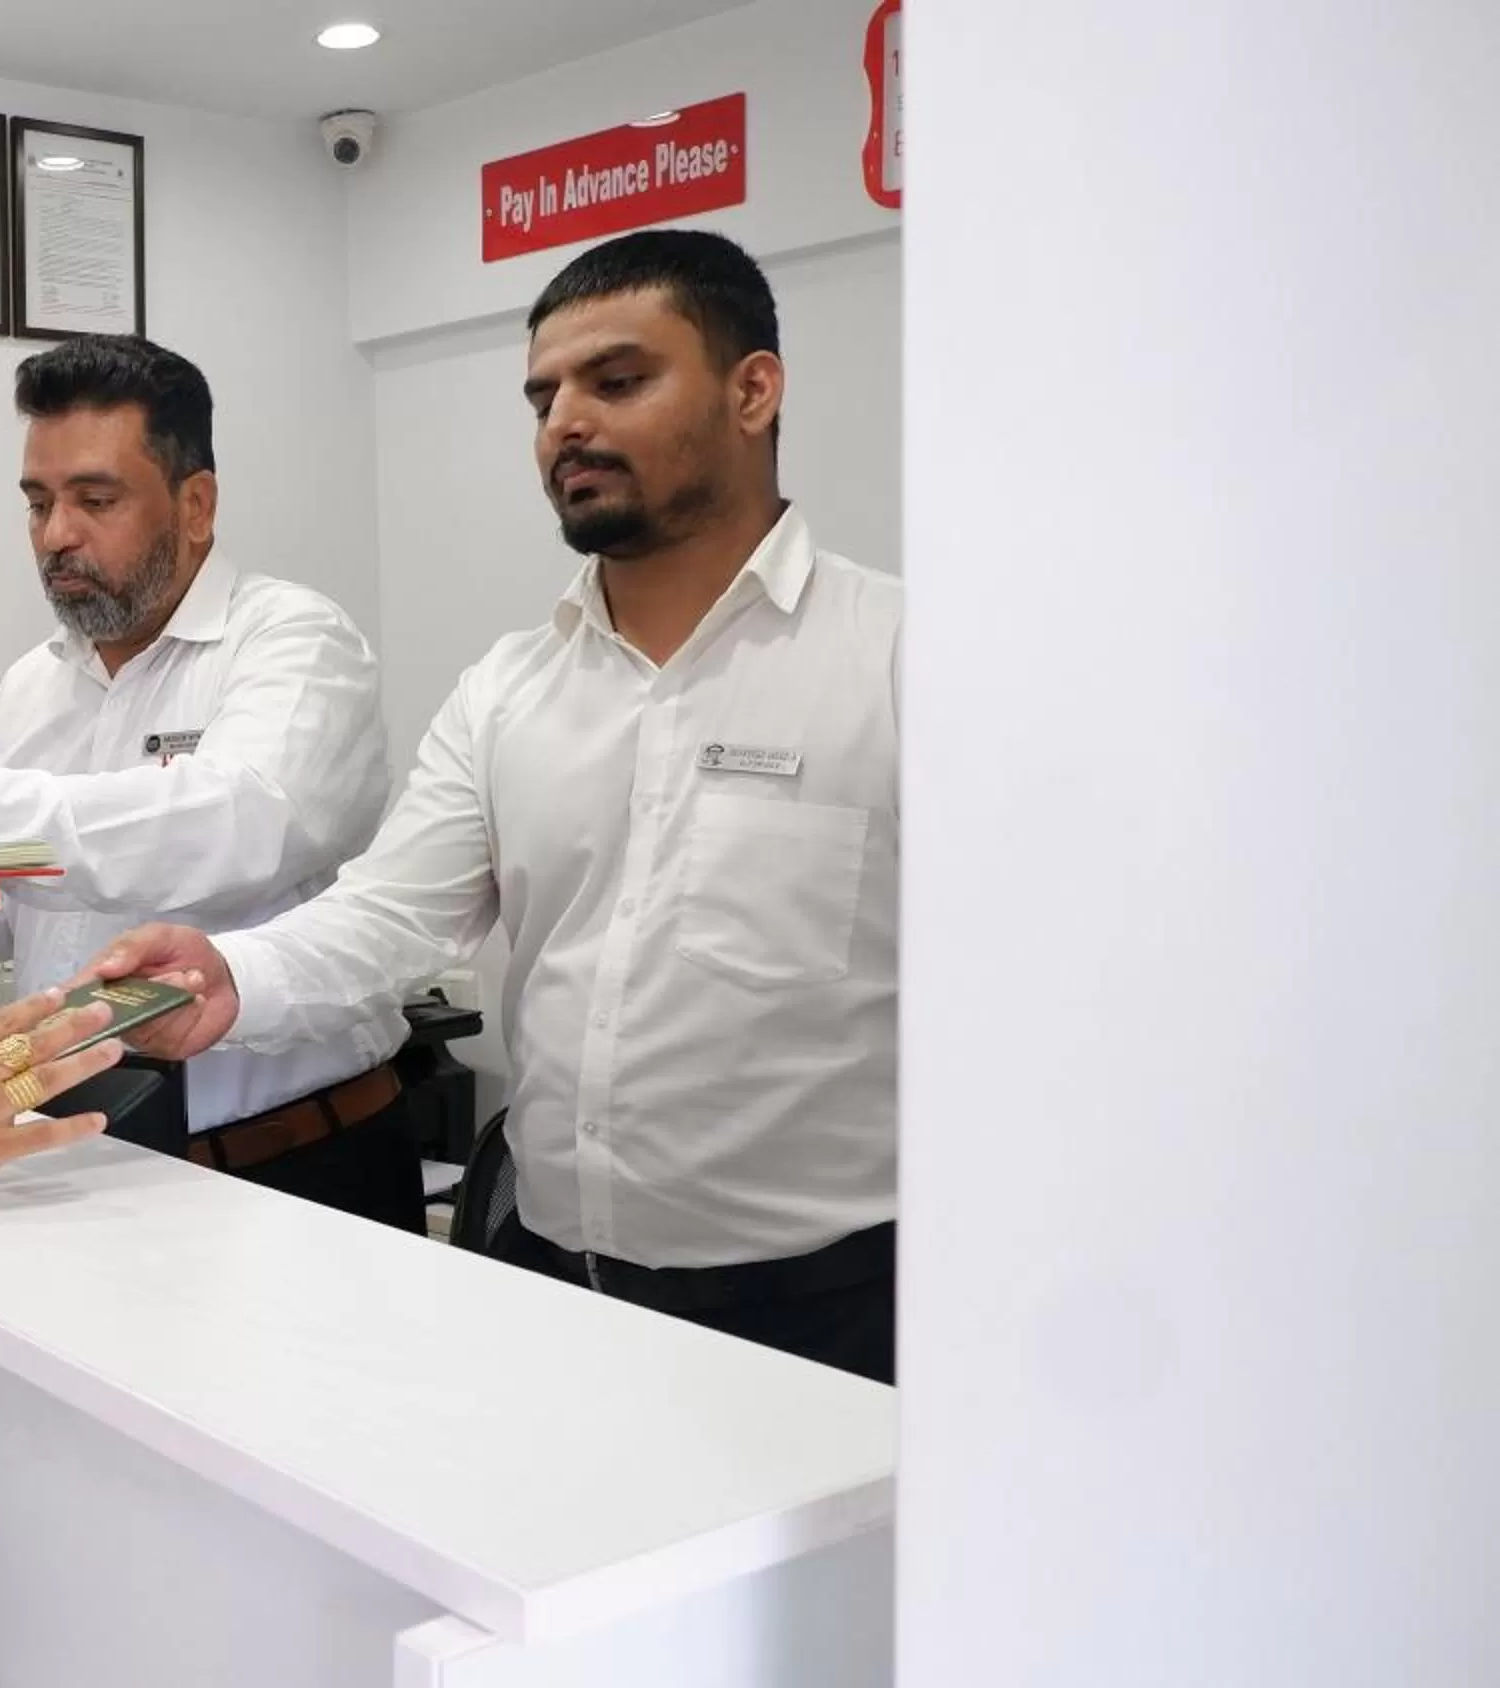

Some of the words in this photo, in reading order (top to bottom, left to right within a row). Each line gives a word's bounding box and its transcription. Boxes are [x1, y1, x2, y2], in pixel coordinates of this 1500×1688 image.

[501, 184, 534, 233] Pay
[539, 175, 557, 217] In
[563, 159, 649, 211] Advance
[655, 138, 728, 188] Please
